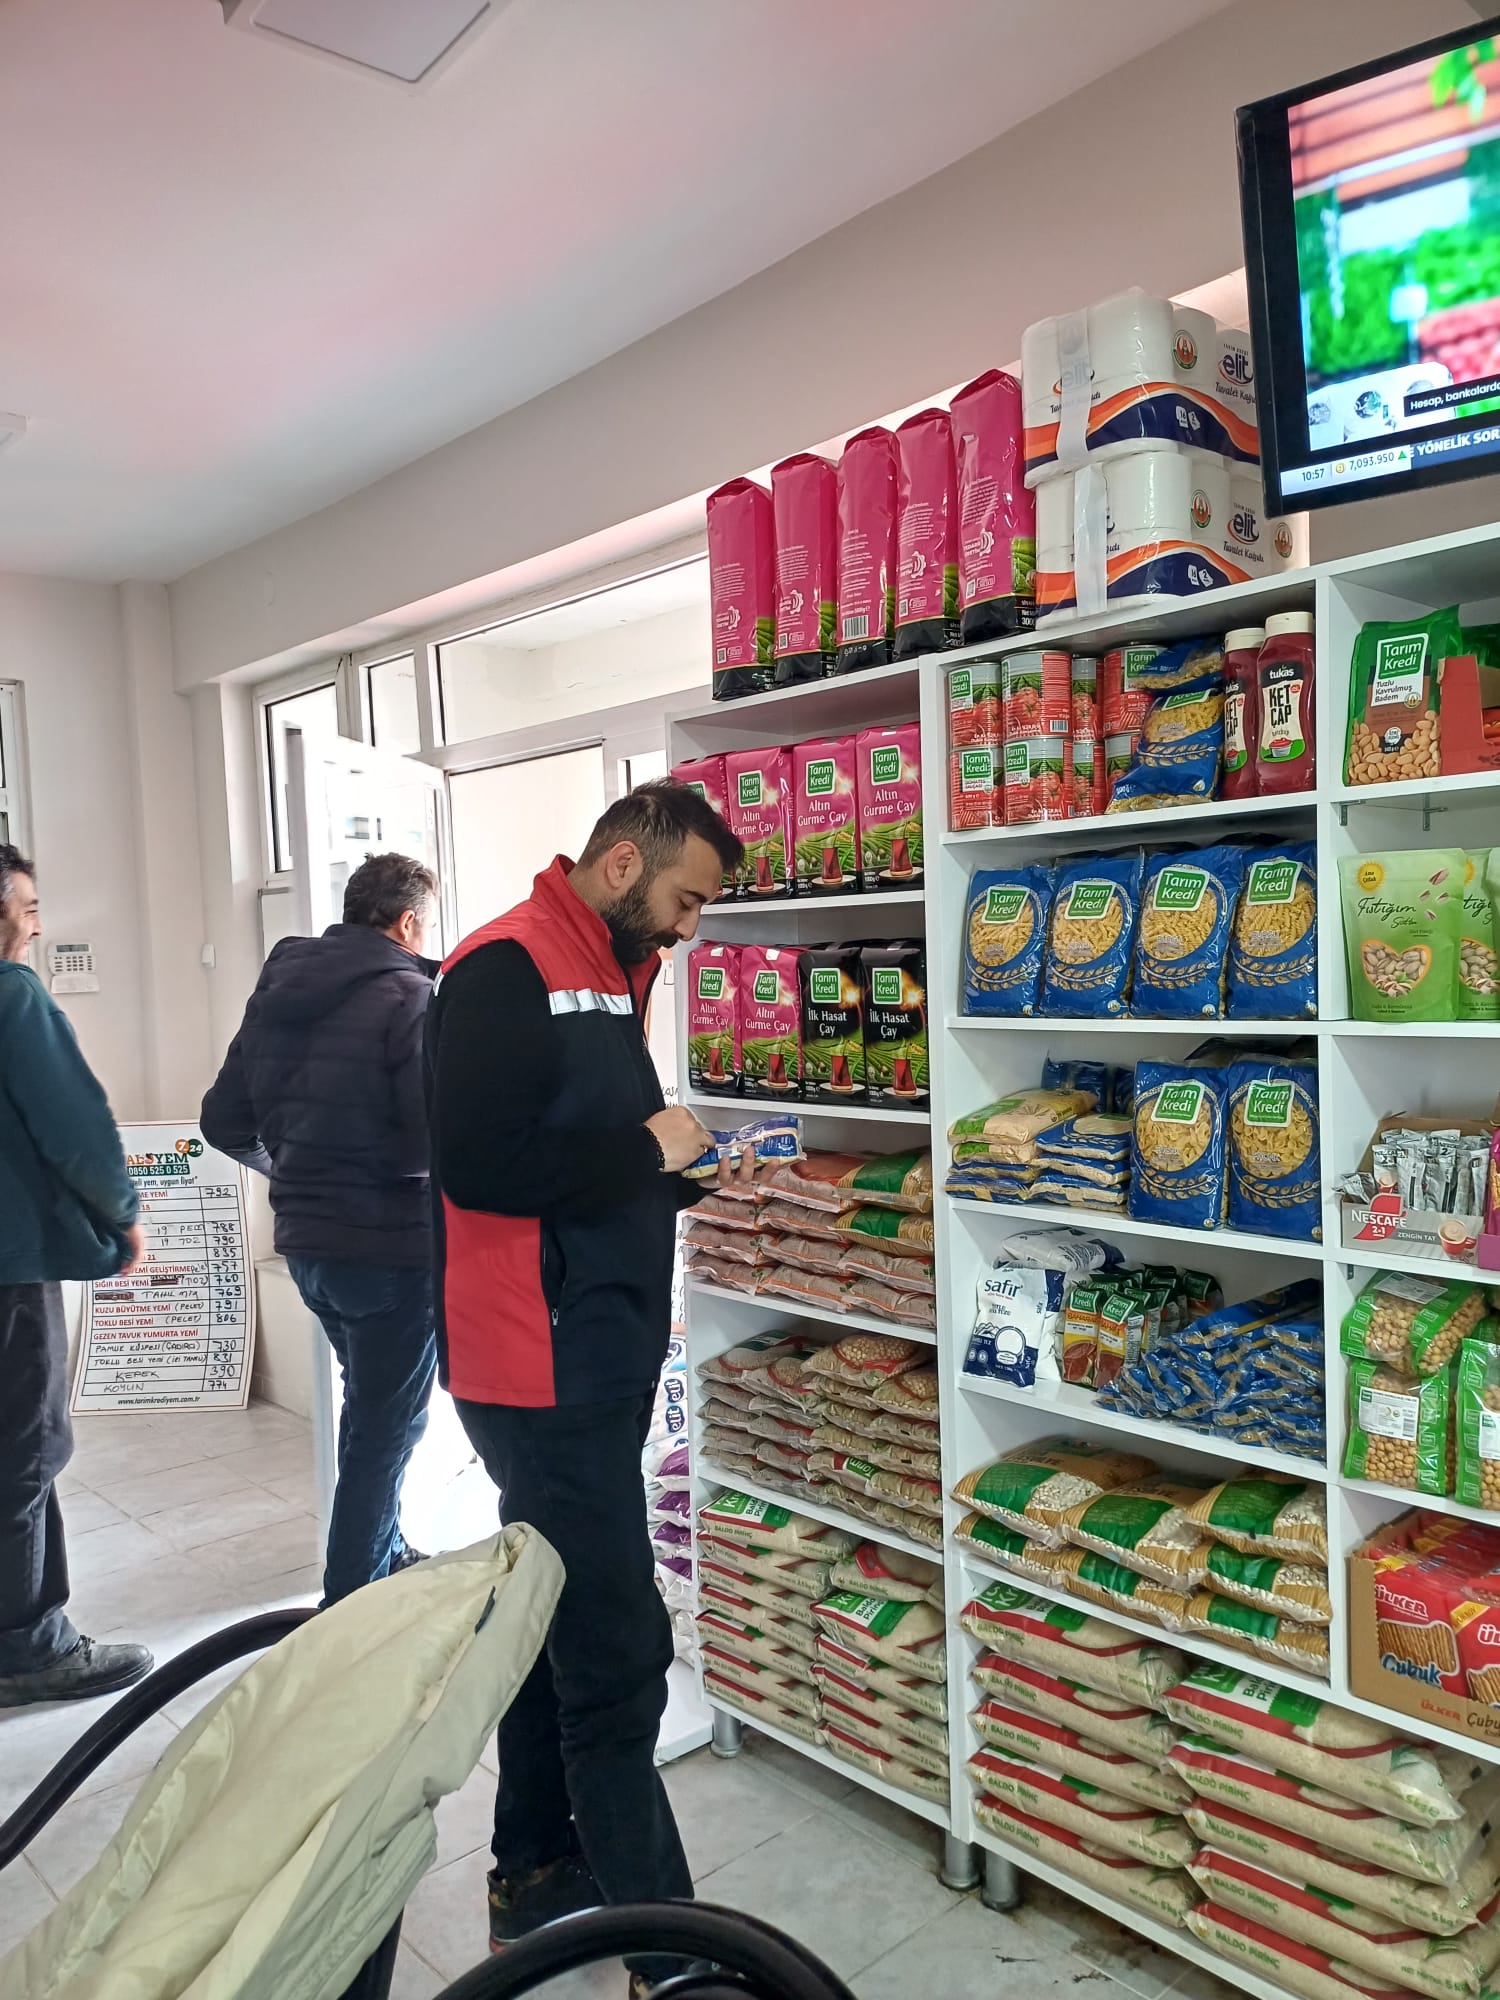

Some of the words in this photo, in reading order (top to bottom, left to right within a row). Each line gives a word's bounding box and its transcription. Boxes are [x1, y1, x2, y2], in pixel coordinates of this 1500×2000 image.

[1222, 353, 1254, 384] elit
[1215, 381, 1238, 398] Tuvalet
[1410, 395, 1444, 411] Hesap,
[1417, 434, 1471, 457] YÖNELİK
[1349, 451, 1395, 472] 7,093.950
[1302, 468, 1325, 482] 10:57
[1232, 512, 1260, 543] elit
[1223, 541, 1243, 557] Tuvalet
[1384, 642, 1422, 657] Tarım
[1385, 654, 1417, 671] Kredi
[1375, 685, 1413, 696] Kavrulmuş
[1376, 680, 1395, 688] Tuzlu
[1269, 684, 1291, 708] KET
[1375, 694, 1399, 702] Badem
[1270, 705, 1292, 728] ÇAP
[874, 751, 898, 764] Tarım
[964, 754, 990, 764] Tarım
[808, 764, 833, 777] Tarım
[875, 762, 897, 775] Kredi
[966, 764, 989, 773] Kredi
[741, 775, 760, 787] Tarım
[810, 775, 831, 787] Kredi
[741, 786, 759, 798] Kredi
[875, 788, 898, 802] Altın
[808, 800, 831, 812] Altın
[863, 802, 894, 817] Gurme
[896, 799, 916, 816] Çay
[742, 810, 761, 822] Altın
[797, 813, 826, 827] Gurme
[828, 810, 848, 826] Çay
[758, 820, 775, 834] Çay
[1258, 865, 1296, 880] Tarım
[1163, 872, 1202, 889] Tarım
[1255, 877, 1289, 893] Kredi
[992, 891, 1024, 905] Tarım
[1077, 886, 1110, 900] Tarım
[1161, 886, 1197, 901] Kredi
[991, 902, 1019, 915] Kredi
[1074, 897, 1105, 911] Kredi
[1357, 896, 1417, 921] Fıstığım
[702, 970, 722, 982] Tarım
[758, 973, 776, 984] Tarım
[815, 973, 838, 984] Tarım
[875, 972, 899, 984] Tarım
[702, 980, 720, 992] Kredi
[757, 983, 775, 995] Kredi
[815, 983, 837, 994] Kredi
[877, 983, 898, 995] Kredi
[755, 1006, 776, 1019] Altın
[808, 1007, 820, 1022] İlk
[821, 1009, 848, 1022] Hasat
[869, 1008, 880, 1023] İlk
[882, 1010, 910, 1024] Hasat
[715, 1015, 729, 1029] Çay
[745, 1019, 771, 1031] Gurme
[773, 1019, 791, 1035] Çay
[819, 1023, 836, 1040] Çay
[880, 1025, 898, 1040] Çay
[1166, 1086, 1198, 1100] Tarım
[1255, 1087, 1290, 1100] Tarım
[1162, 1099, 1192, 1113] Kredi
[1253, 1099, 1285, 1114] Kredi
[179, 1142, 187, 1151] 7
[129, 1166, 148, 1176] 0850
[150, 1166, 165, 1175] 525
[173, 1165, 188, 1174] 525
[150, 1190, 168, 1198] YEMİ
[1397, 1231, 1423, 1241] ZENGİN
[95, 1279, 113, 1288] SIĞIR
[114, 1278, 130, 1288] BESİ
[131, 1277, 150, 1287] YEMİ
[984, 1279, 1020, 1298] safir
[95, 1305, 114, 1314] KUZU
[115, 1303, 151, 1313] BÜYÜTME
[152, 1302, 171, 1312] YEMİ
[95, 1318, 118, 1327] TOKLU
[119, 1317, 134, 1326] BESİ
[134, 1316, 154, 1326] YEMİ
[93, 1331, 117, 1340] GEZEN
[118, 1330, 142, 1340] TAVUK
[143, 1329, 179, 1339] YUMURTA
[180, 1328, 199, 1337] YEMİ
[115, 1371, 161, 1383] KEPEK
[668, 1406, 684, 1433] elit
[1376, 1583, 1428, 1618] ÜLKER
[991, 1723, 1016, 1741] BALDO
[988, 1777, 1015, 1793] BALDO
[991, 1814, 1016, 1833] BALDO
[1213, 1876, 1247, 1898] BALDO
[1215, 1929, 1247, 1953] BALDO
